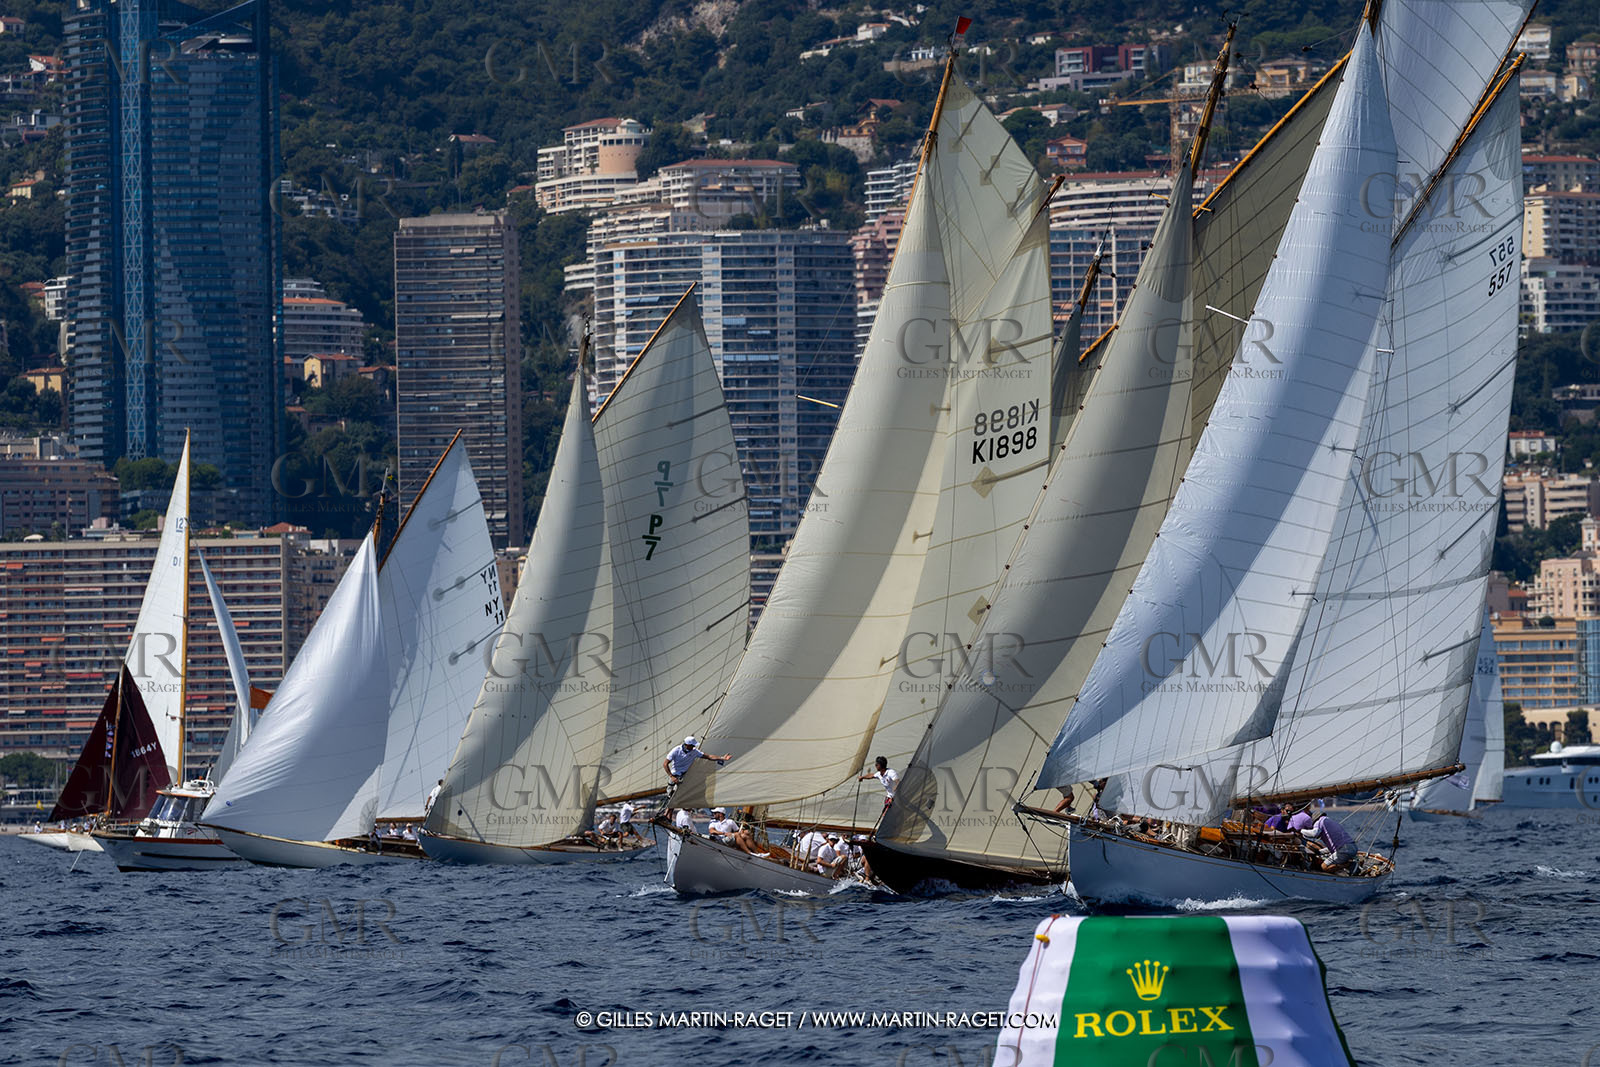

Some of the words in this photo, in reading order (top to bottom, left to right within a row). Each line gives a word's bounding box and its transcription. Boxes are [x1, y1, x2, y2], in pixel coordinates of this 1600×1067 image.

[1488, 260, 1514, 297] 557
[972, 426, 1037, 464] K1898
[175, 517, 184, 529] 12
[649, 514, 663, 534] P
[645, 541, 657, 560] 7
[485, 596, 499, 616] NY
[494, 609, 504, 625] 11
[1073, 1006, 1235, 1038] ROLEX
